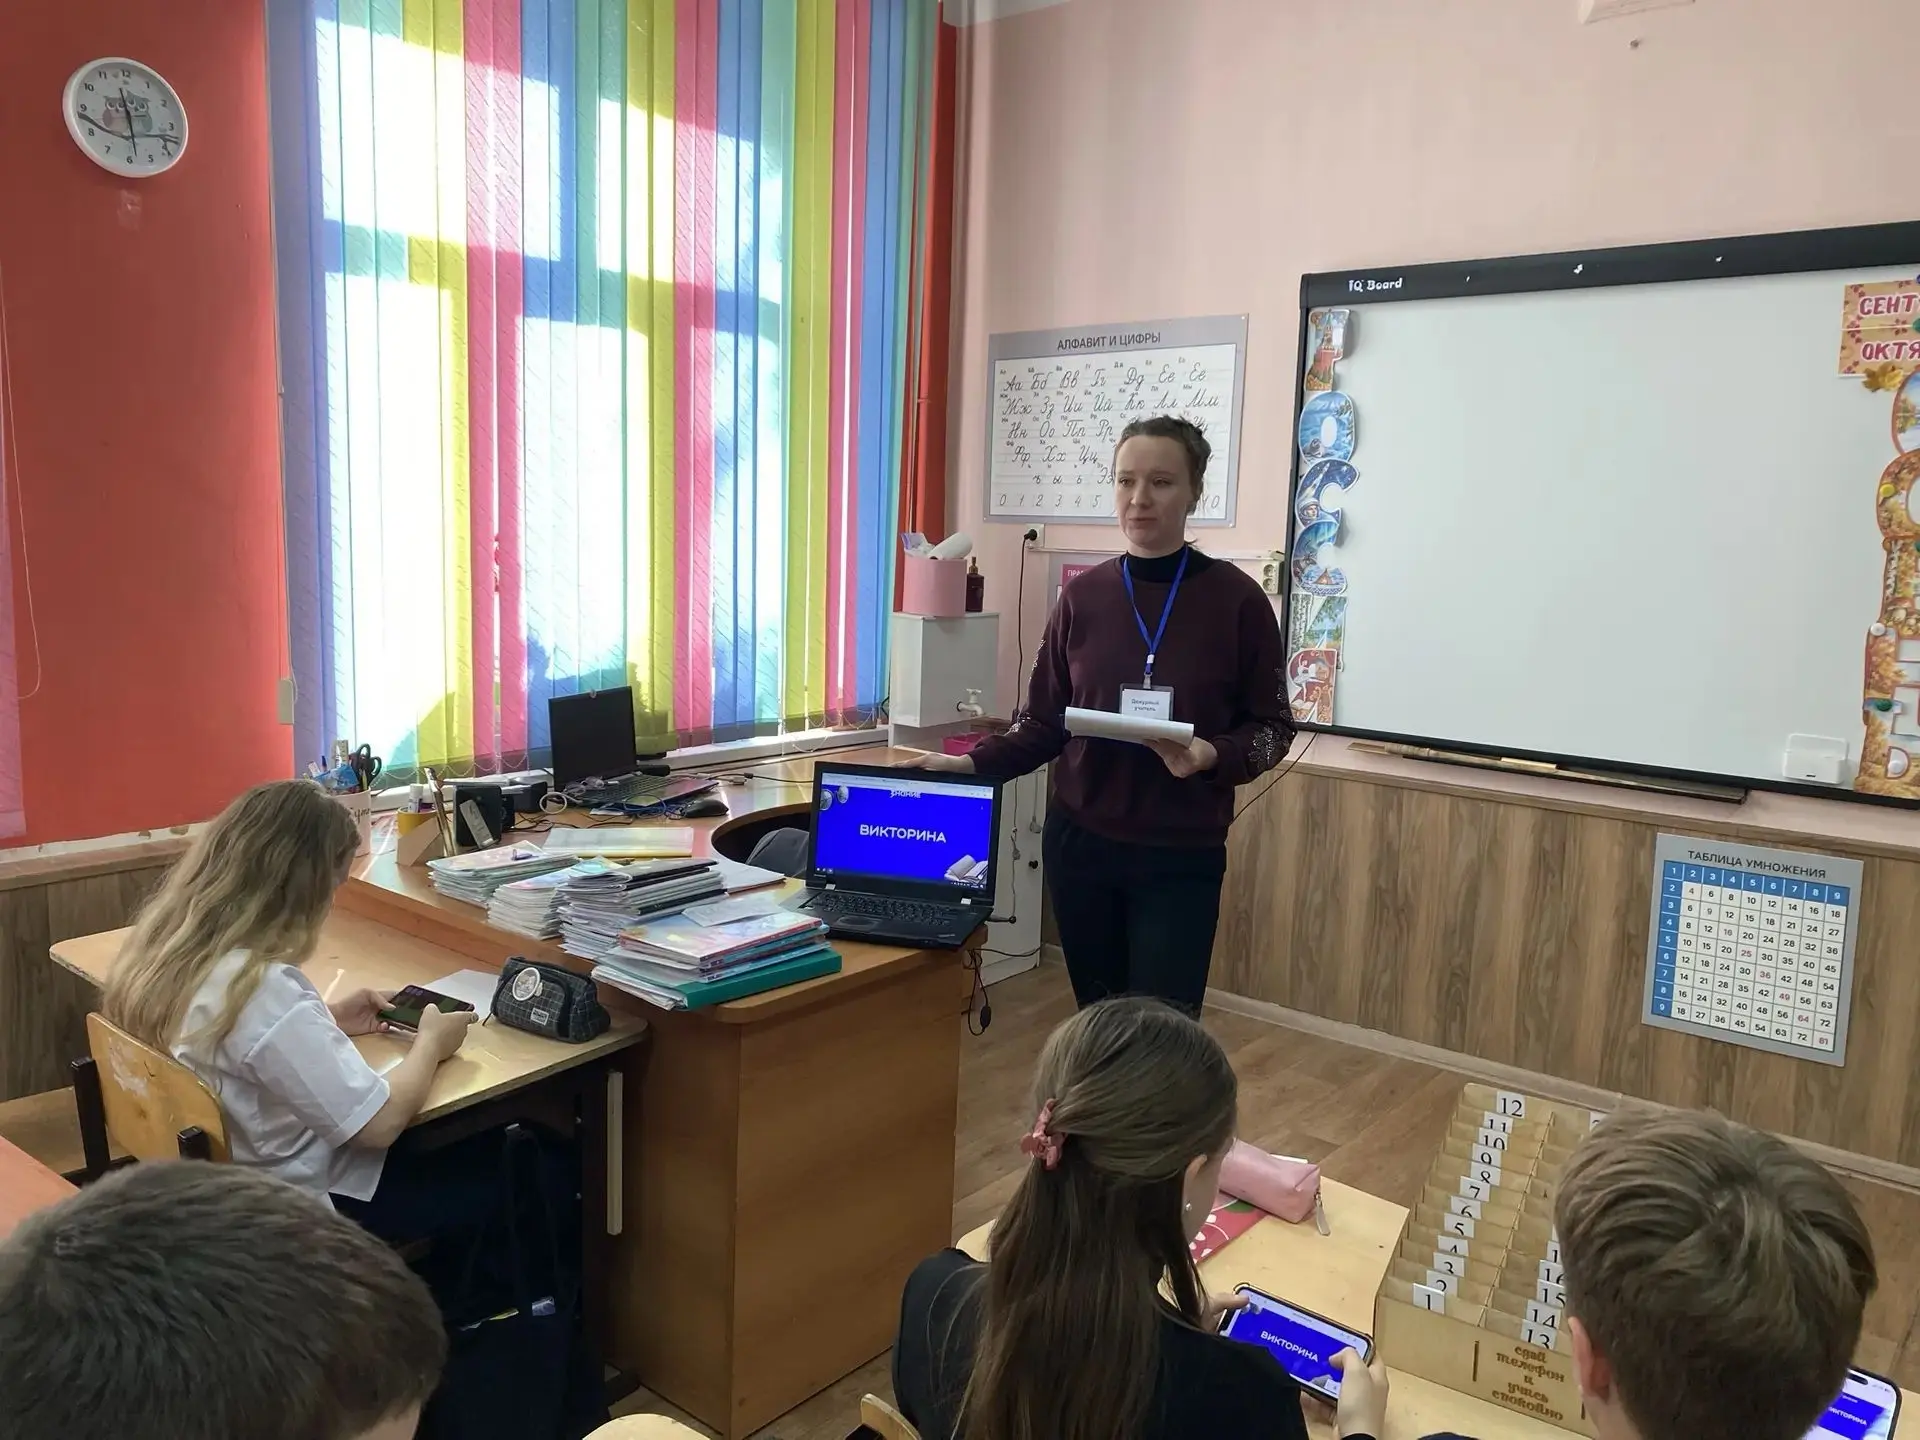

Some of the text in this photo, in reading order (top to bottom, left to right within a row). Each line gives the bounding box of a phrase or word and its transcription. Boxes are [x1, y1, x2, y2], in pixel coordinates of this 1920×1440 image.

[99, 71, 107, 79] 11
[121, 70, 131, 78] 12
[85, 83, 94, 91] 10
[80, 104, 87, 112] 9
[161, 99, 167, 107] 2
[89, 128, 95, 136] 8
[169, 122, 174, 131] 3
[126, 156, 133, 164] 6
[1348, 277, 1403, 292] IQ Board
[1860, 295, 1920, 316] СЕНТ
[1057, 332, 1161, 351] АЛФАВИТ И ЦИФРЫ
[1003, 375, 1023, 391] Аа
[1031, 371, 1053, 390] Бб
[1060, 370, 1080, 389] Вв
[1002, 397, 1032, 415] Жж
[1185, 388, 1219, 408] Мм
[1007, 419, 1113, 442] Нн Оо Пп Рр
[1012, 446, 1031, 467] Фф
[1042, 445, 1067, 462] Хх
[1000, 494, 1102, 507] 0 1 2 3 4 5
[859, 824, 946, 843] ВИКТОРИНА
[1688, 850, 1826, 879] ТАБЛИЦА УМНОЖЕНИЯ
[1672, 867, 1819, 897] 1 2 3 4 5 6 7 8
[1768, 900, 1777, 908] 12
[1809, 907, 1819, 915] 16
[1831, 910, 1840, 918] 18
[1726, 911, 1734, 919] 12
[1746, 914, 1754, 922] 15
[1766, 918, 1775, 926] 18
[1787, 921, 1796, 929] 21
[1828, 928, 1840, 936] 27
[1704, 925, 1713, 933] 12
[1742, 932, 1754, 940] 20
[1784, 939, 1795, 947] 28
[1805, 943, 1816, 951] 32
[1826, 946, 1838, 955] 36
[1703, 942, 1711, 950] 15
[1721, 946, 1732, 954] 20
[1761, 953, 1773, 961] 30
[1782, 957, 1793, 965] 35
[1803, 961, 1815, 969] 40
[1825, 965, 1836, 973] 45
[1682, 956, 1690, 964] 12
[1720, 963, 1730, 971] 24
[1739, 967, 1751, 975] 30
[1781, 975, 1792, 983] 42
[1801, 979, 1813, 987] 48
[1823, 983, 1834, 991] 54
[1718, 980, 1728, 989] 28
[1738, 984, 1749, 993] 35
[1758, 989, 1769, 997] 42
[1800, 997, 1811, 1005] 56
[1821, 1001, 1833, 1009] 63
[1679, 990, 1687, 998] 16
[1697, 994, 1707, 1002] 24
[1716, 998, 1727, 1006] 32
[1736, 1002, 1747, 1010] 40
[1777, 1010, 1788, 1019] 56
[1820, 1019, 1831, 1027] 72
[1677, 1007, 1807, 1041] 18 27 36 45 54 63 72
[1502, 1098, 1522, 1117] 12
[1488, 1119, 1506, 1132] 11
[1484, 1135, 1505, 1150] 10
[1481, 1152, 1492, 1165] 9
[1480, 1170, 1491, 1184] 8
[1469, 1185, 1480, 1198] 7
[1461, 1205, 1472, 1217] 6
[1454, 1222, 1464, 1236] 5
[1444, 1261, 1454, 1274] 3
[1426, 1294, 1431, 1310] 1
[1543, 1288, 1566, 1307] 15
[1532, 1309, 1557, 1329] 14
[1260, 1331, 1318, 1363] ВИКТОРИНА
[1527, 1328, 1549, 1349] 13
[1514, 1346, 1547, 1363] сдай
[1496, 1352, 1565, 1382] телефон
[1524, 1375, 1534, 1385] и
[1492, 1390, 1564, 1421] спокойно
